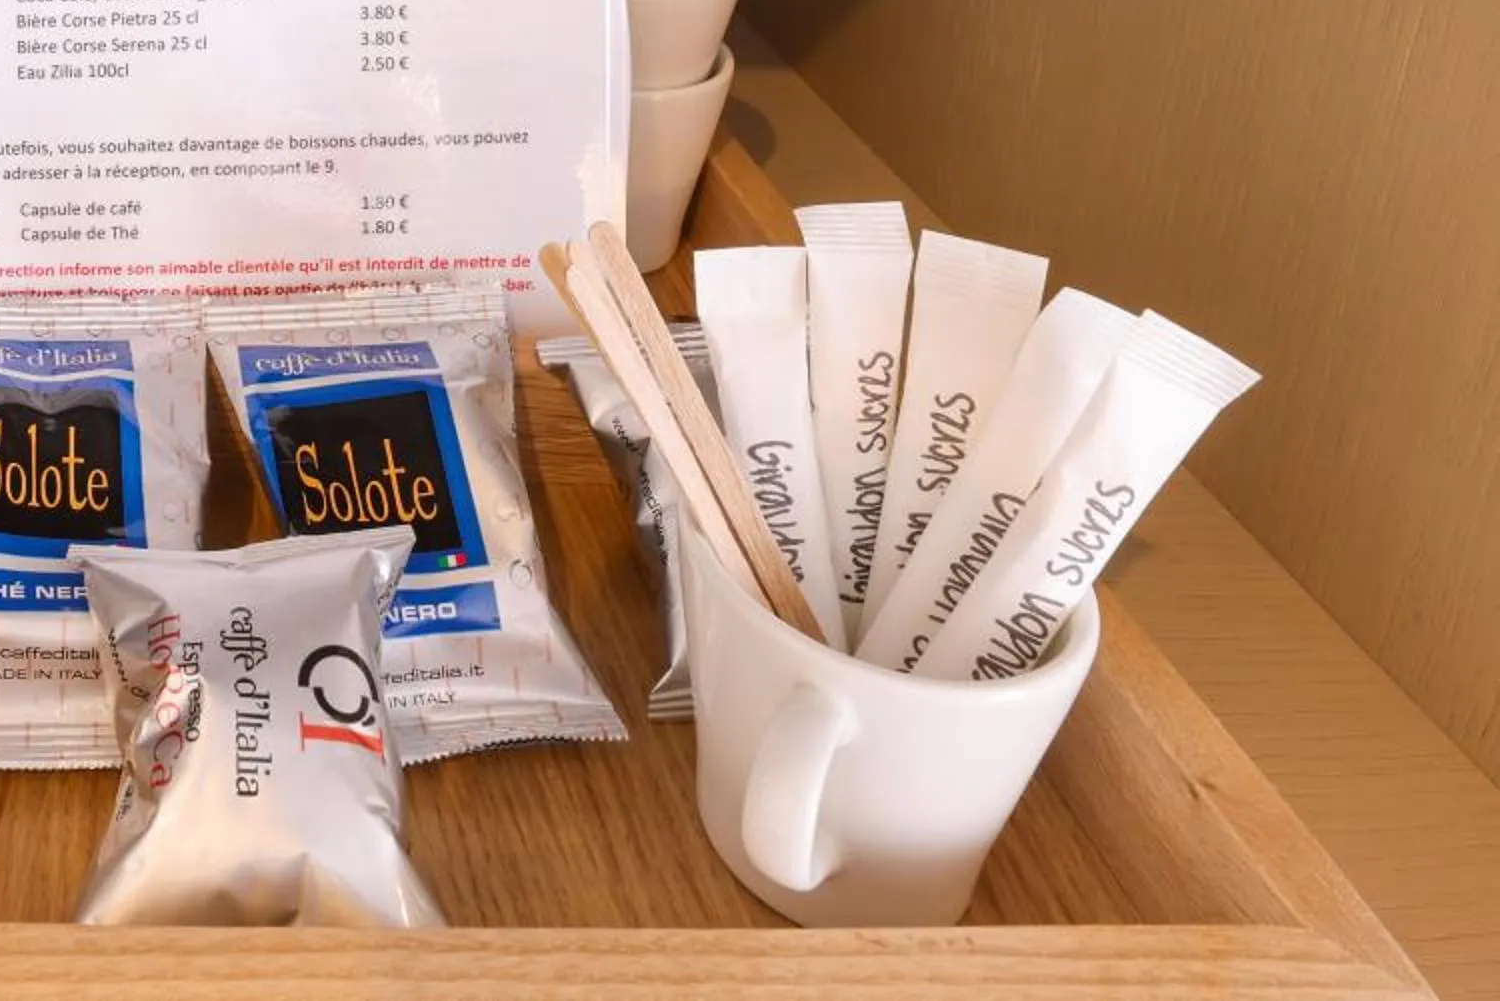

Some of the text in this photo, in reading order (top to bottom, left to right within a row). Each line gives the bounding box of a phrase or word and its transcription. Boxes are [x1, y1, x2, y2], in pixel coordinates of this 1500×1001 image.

[15, 10, 199, 29] Bière Corse Pietra 25 cl
[360, 5, 408, 20] 3.80 €
[16, 35, 208, 55] Bière Corse Serena 25 cl
[360, 31, 409, 46] 3.80 €
[17, 63, 130, 80] Eau Zilia 100cl
[361, 55, 409, 72] 2.50 €
[57, 142, 96, 155] vous
[98, 138, 174, 154] souhaitez
[178, 136, 260, 155] davantage
[263, 137, 284, 150] de
[288, 133, 357, 151] boissons
[359, 132, 428, 148] chaudes,
[434, 133, 470, 146] vous
[473, 131, 529, 147] pouvez
[2, 166, 71, 181] adresser
[72, 165, 84, 179] à
[87, 164, 102, 179] la
[105, 163, 185, 179] réception,
[189, 165, 210, 177] en
[213, 162, 302, 177] composant
[304, 159, 323, 174] le
[324, 159, 338, 174] 9.
[19, 201, 142, 219] Capsule de café
[398, 194, 410, 209] €
[20, 225, 140, 243] Capsule de Thé
[361, 219, 409, 235] 1.80 €
[58, 263, 125, 277] informe
[124, 264, 156, 276] son
[157, 260, 224, 275] aimable
[226, 259, 296, 274] clientèle
[298, 258, 335, 275] qu'il
[338, 259, 362, 272] est
[366, 257, 424, 271] interdit
[428, 257, 449, 271] de
[451, 255, 510, 270] mettre
[509, 254, 531, 268] de
[27, 348, 117, 367] d'Italia
[326, 348, 420, 367] d'Italia
[295, 438, 437, 525] Solote
[33, 668, 52, 680] IN
[59, 667, 103, 680] ITALY
[178, 641, 204, 742] Espresso
[412, 691, 457, 708] ITALY
[219, 606, 273, 797] caffè d'Italia
